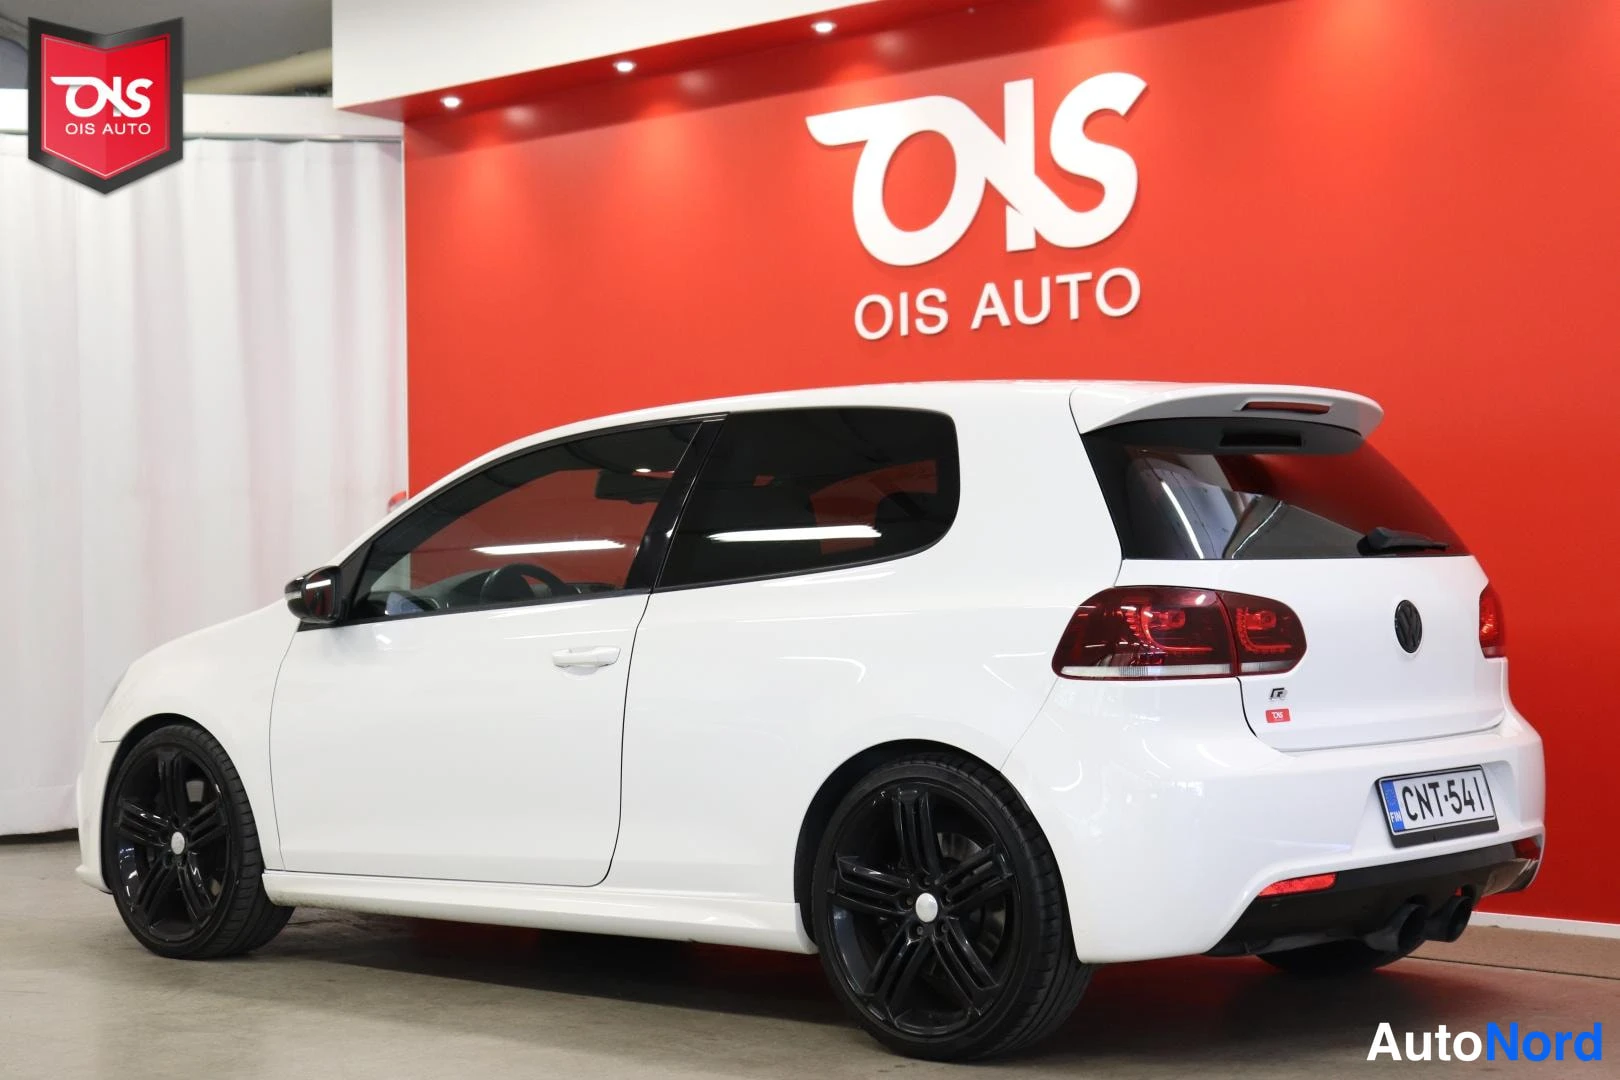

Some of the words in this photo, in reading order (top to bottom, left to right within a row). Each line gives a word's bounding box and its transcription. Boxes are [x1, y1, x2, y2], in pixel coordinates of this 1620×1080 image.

[854, 287, 949, 341] OIS
[970, 267, 1142, 331] AUTO
[1389, 810, 1402, 823] FIN
[1402, 776, 1485, 821] CNT-541
